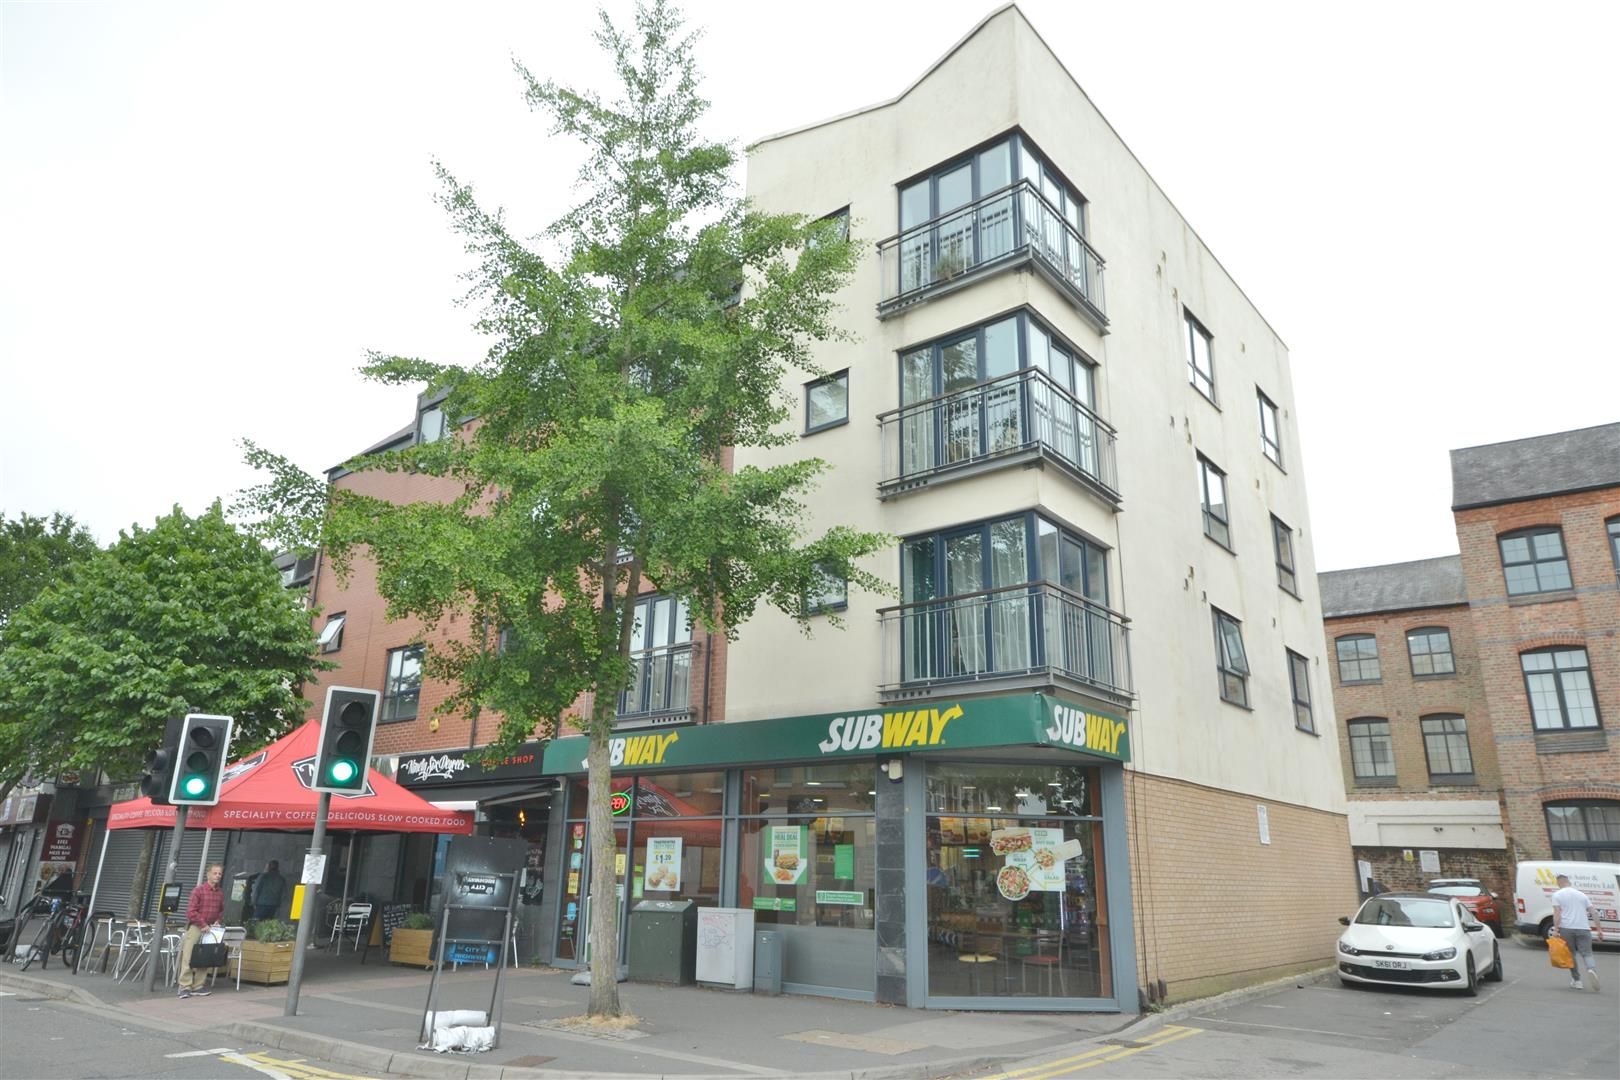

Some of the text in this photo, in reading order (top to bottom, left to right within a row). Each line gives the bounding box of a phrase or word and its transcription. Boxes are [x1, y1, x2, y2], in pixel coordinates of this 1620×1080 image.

[818, 704, 964, 754] SUBWAY
[1046, 705, 1126, 752] SUBWAY
[512, 753, 535, 765] SHOP
[582, 731, 679, 770] BWAY
[611, 796, 627, 810] PEN
[223, 810, 465, 826] SPECIALITY COFFE DELICIOUS SLOW COOKED FOOD
